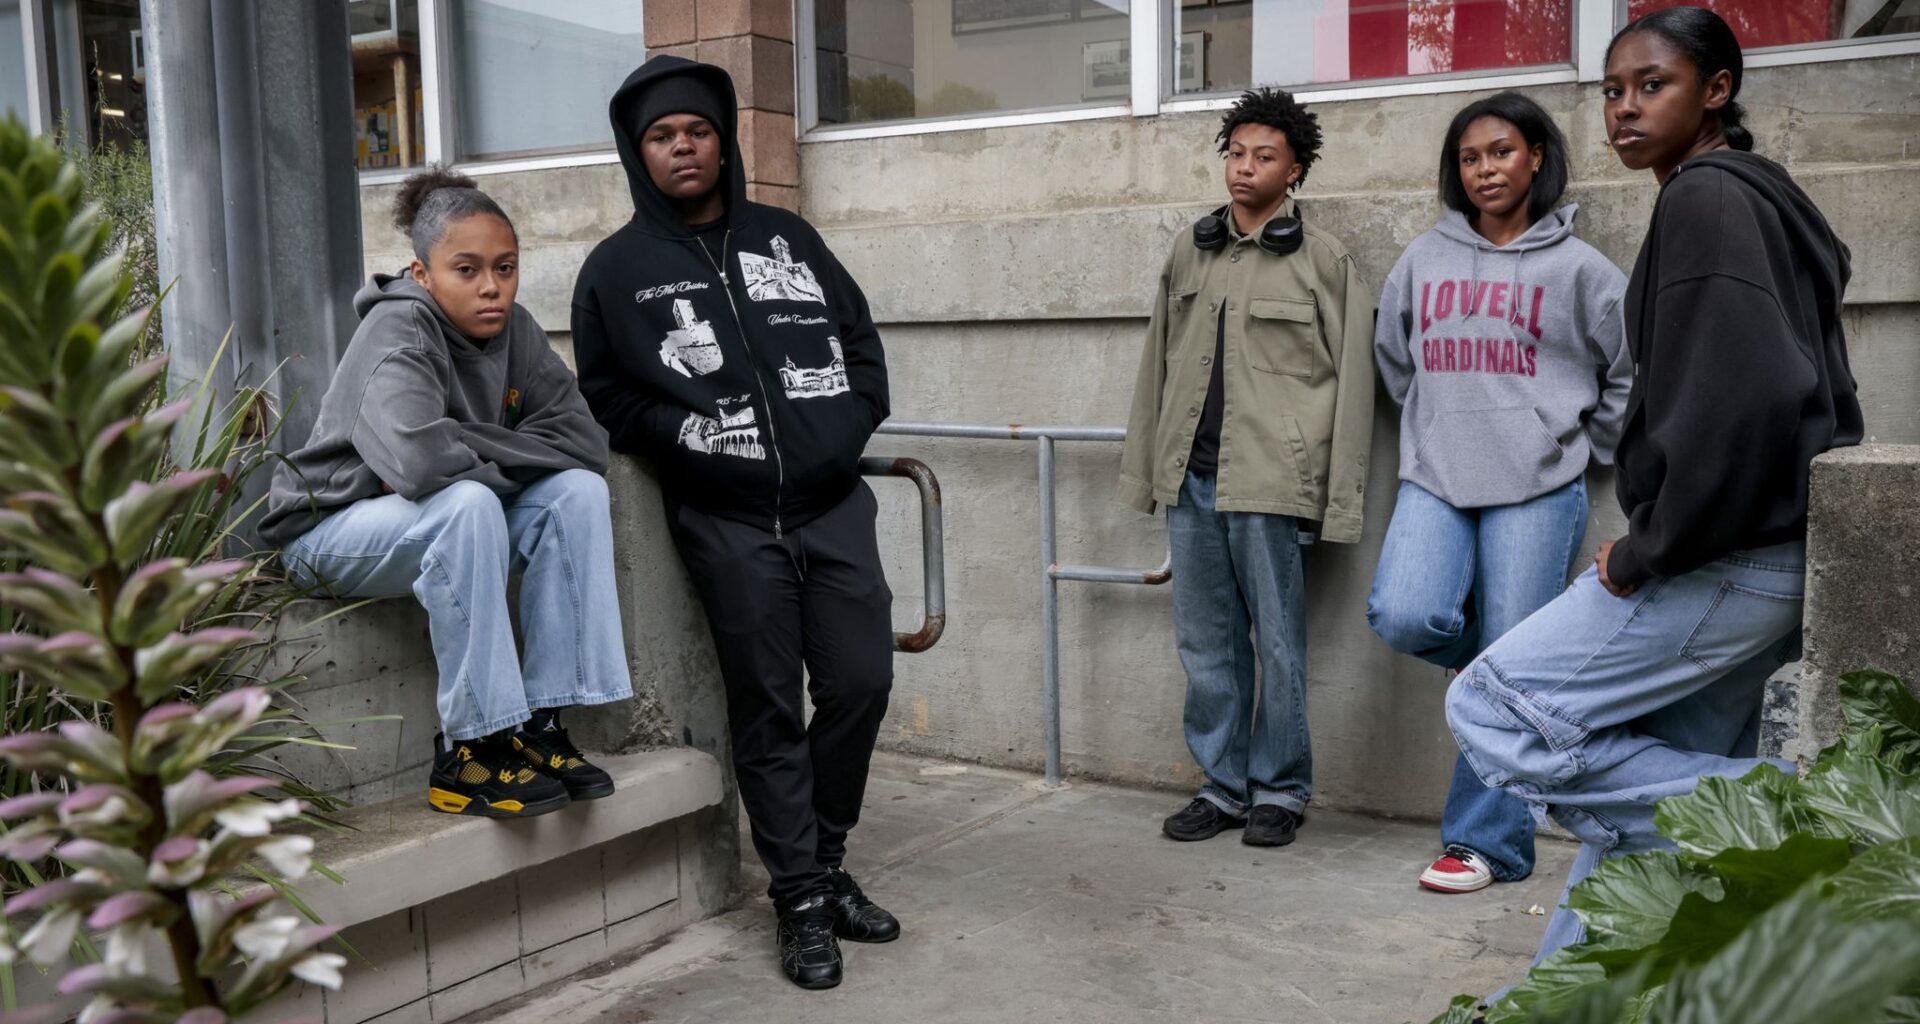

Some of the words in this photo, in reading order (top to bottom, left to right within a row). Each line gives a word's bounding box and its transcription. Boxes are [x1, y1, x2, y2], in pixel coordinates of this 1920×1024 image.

[635, 286, 657, 303] The
[1420, 279, 1546, 341] LOWELL
[1422, 337, 1537, 379] CARDINALS
